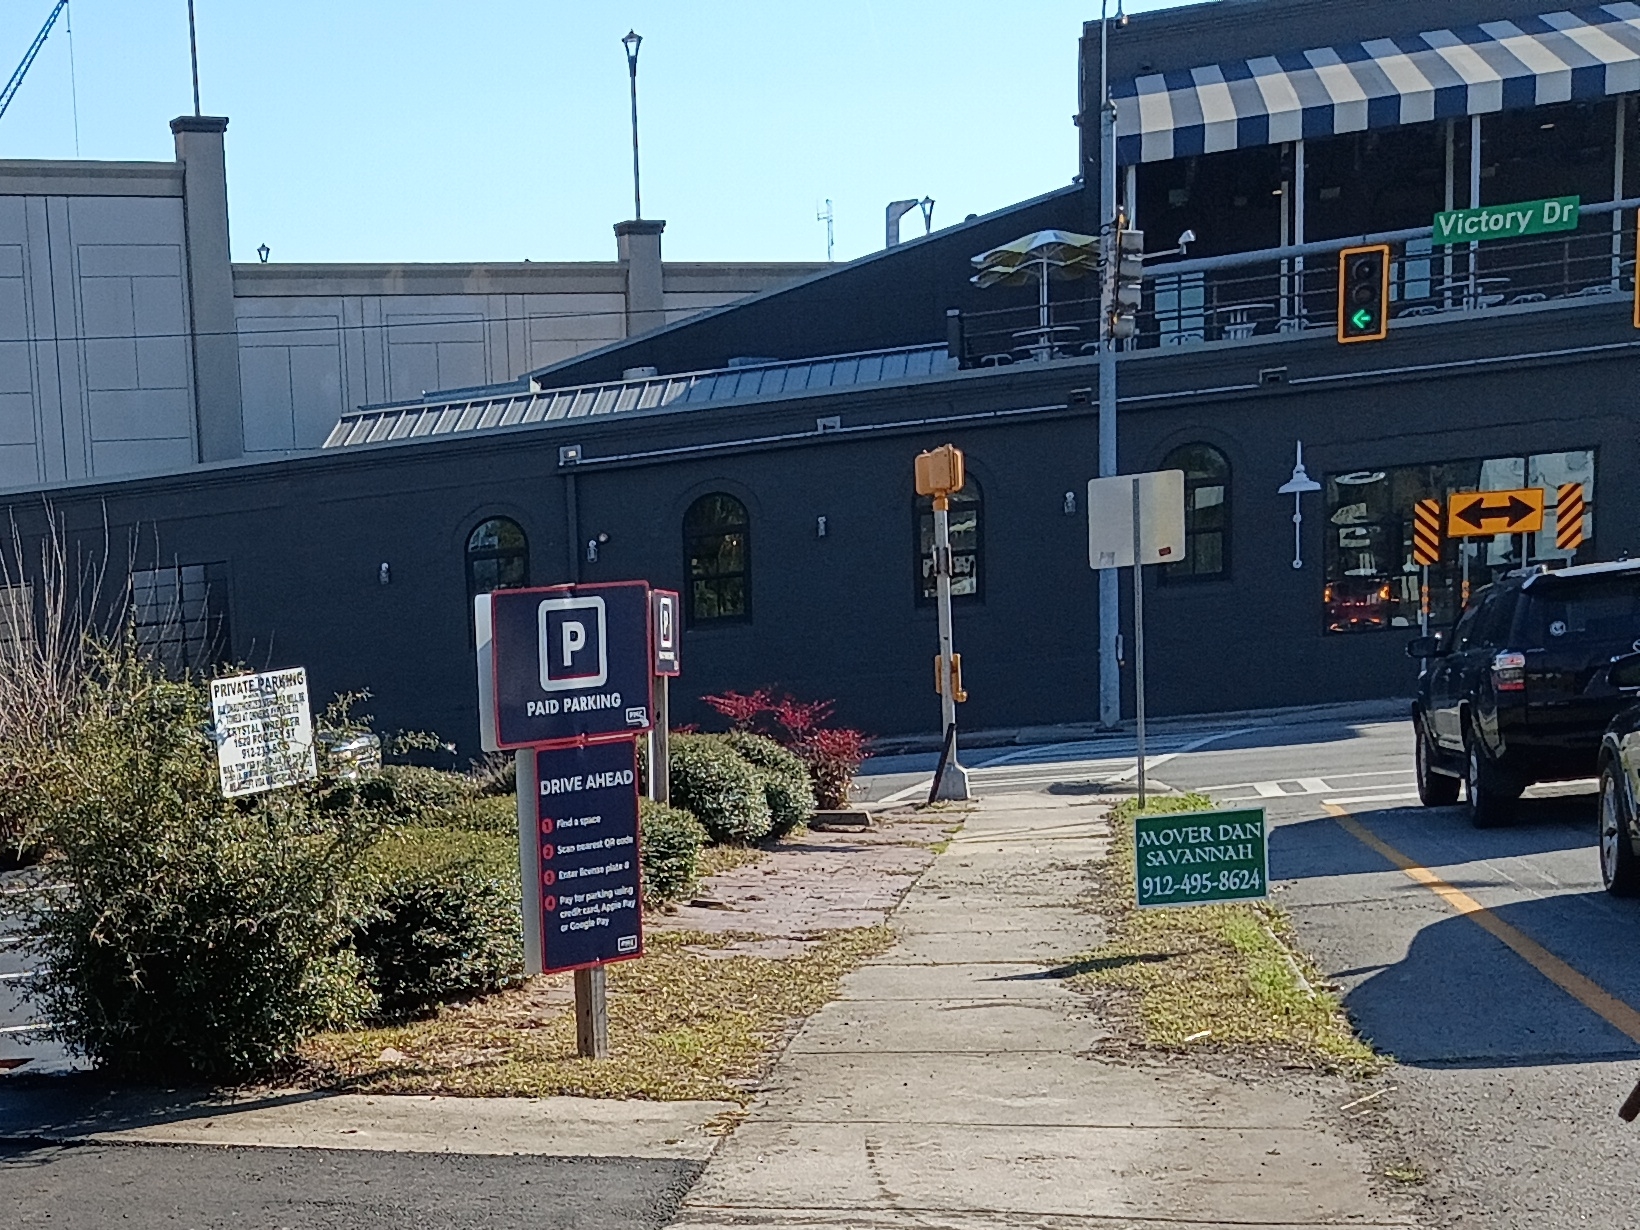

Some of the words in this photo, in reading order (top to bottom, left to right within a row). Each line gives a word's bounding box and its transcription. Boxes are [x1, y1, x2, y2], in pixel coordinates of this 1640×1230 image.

[1438, 209, 1534, 237] Victory
[1543, 201, 1574, 225] Dr
[561, 620, 586, 667] P
[213, 680, 256, 699] PRIVATE
[257, 671, 304, 690] PARKING
[526, 700, 560, 717] PAID
[563, 692, 622, 713] PARKING
[540, 775, 583, 796] DRIVE
[585, 769, 634, 790] AHEAD
[556, 816, 573, 830] Find
[579, 815, 601, 827] space
[557, 845, 576, 855] Scan
[576, 840, 603, 852] nearest
[604, 837, 616, 848] QR
[1138, 826, 1215, 848] MOVER
[1218, 822, 1261, 841] DAN
[1145, 843, 1254, 867] SAVANNAH
[558, 870, 579, 880] Enter
[605, 862, 623, 875] plate
[1142, 867, 1261, 898] 912-495-8624
[559, 896, 574, 906] Pay
[585, 889, 614, 903] parking
[614, 885, 634, 896] using
[560, 907, 583, 919] credit
[601, 900, 622, 913] Apple
[622, 898, 636, 909] Pay
[569, 916, 596, 930] Google
[596, 917, 610, 927] Pay
